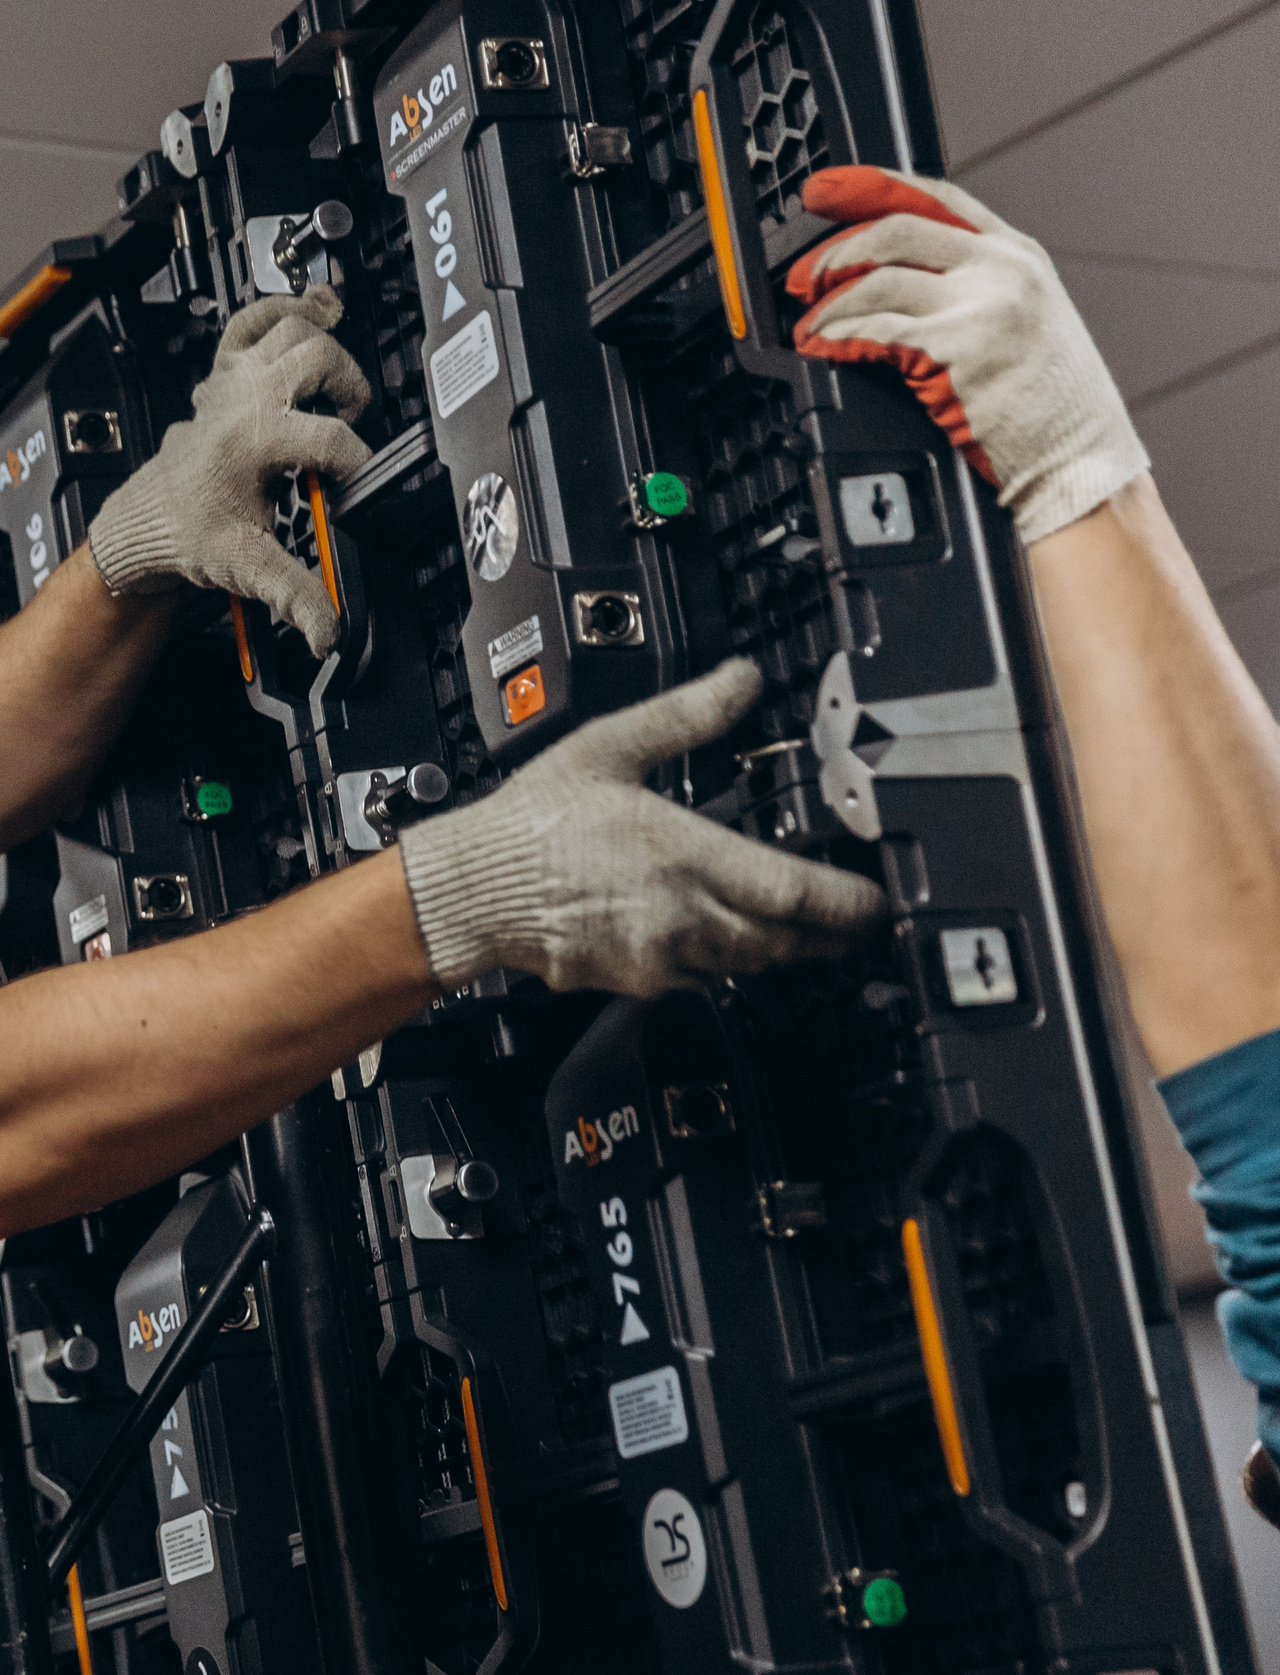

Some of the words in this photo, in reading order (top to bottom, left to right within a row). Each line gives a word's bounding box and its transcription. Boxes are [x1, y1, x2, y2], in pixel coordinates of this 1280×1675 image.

[390, 63, 457, 147] Absen
[395, 106, 467, 179] SCREENMASTER
[564, 1105, 640, 1165] Absen
[600, 1196, 641, 1305] 765
[128, 1302, 182, 1350] Absen
